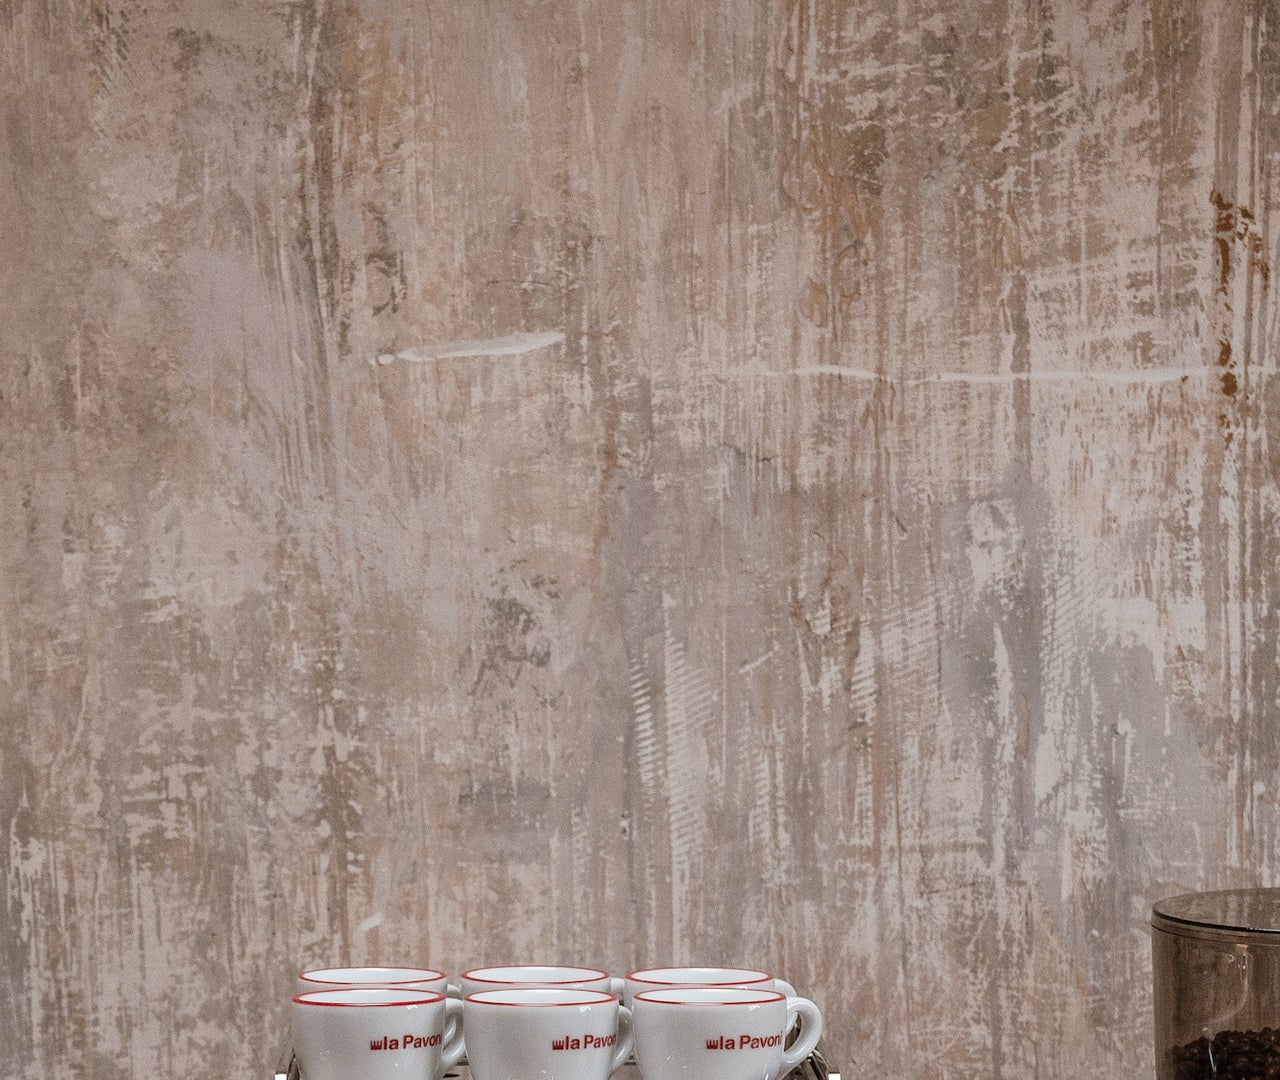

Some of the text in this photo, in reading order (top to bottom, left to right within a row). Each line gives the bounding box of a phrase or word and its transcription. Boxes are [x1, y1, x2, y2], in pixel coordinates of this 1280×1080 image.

[383, 1036, 399, 1050] la
[565, 1036, 580, 1050] la
[720, 1030, 783, 1050] la Pavoni
